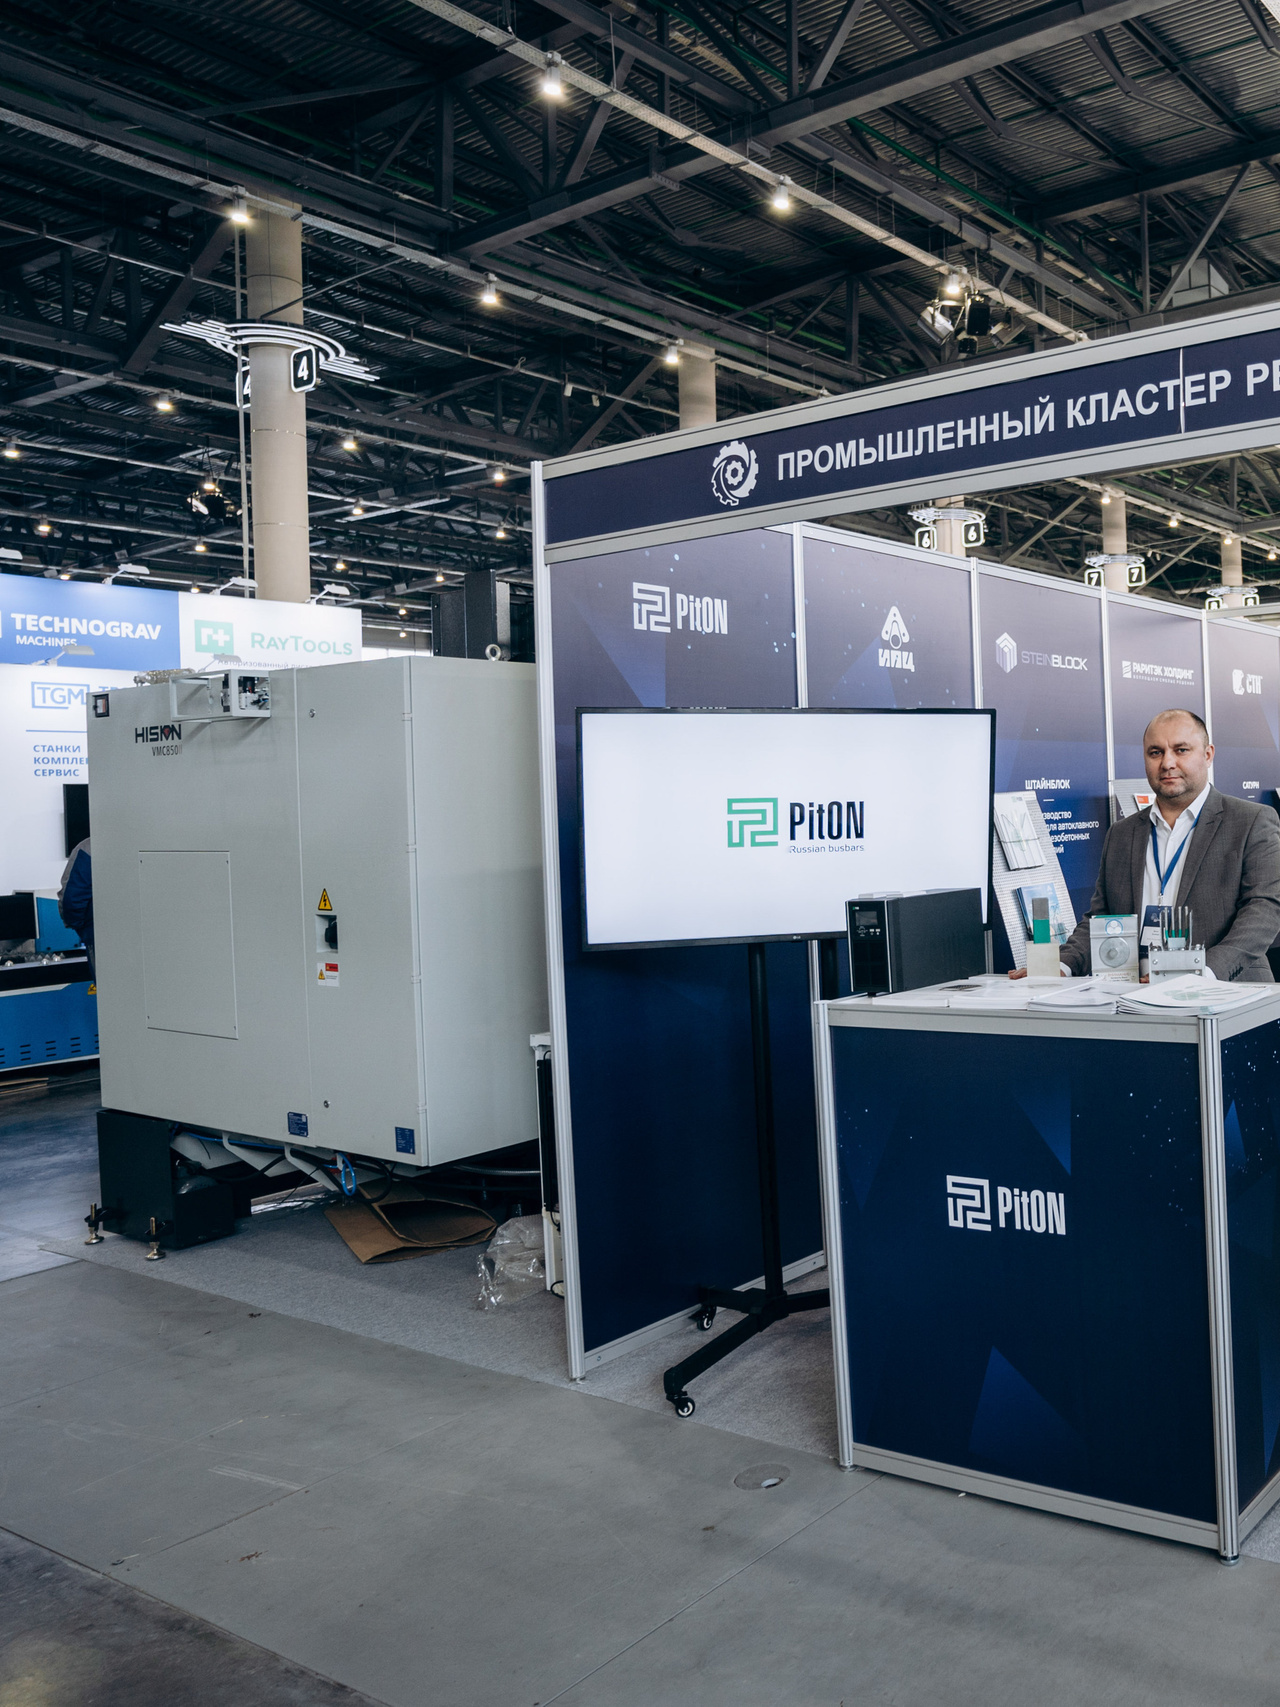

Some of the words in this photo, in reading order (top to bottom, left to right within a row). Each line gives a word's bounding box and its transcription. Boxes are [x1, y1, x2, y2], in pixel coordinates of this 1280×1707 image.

[297, 355, 309, 381] 4
[777, 395, 1055, 481] ПРОМЫШЛЕННЫЙ
[1066, 369, 1232, 429] КЛАСТЕР
[921, 532, 931, 548] 6
[967, 525, 978, 542] 6
[1089, 573, 1099, 586] 7
[1130, 567, 1140, 582] 7
[676, 592, 728, 635] PitON
[10, 613, 162, 641] TECHNOGRAV
[16, 634, 78, 648] MACHINES
[1021, 651, 1088, 671] STEINBLOCK
[36, 686, 86, 706] TGM
[33, 744, 81, 753] СТАНКИ
[33, 768, 80, 777] СЕРВИС
[1025, 777, 1071, 790] ШТАЙНБЛОК
[789, 800, 865, 841] PitON
[789, 845, 826, 854] Russian
[828, 844, 865, 853] busbars
[997, 1185, 1067, 1236] PitON
